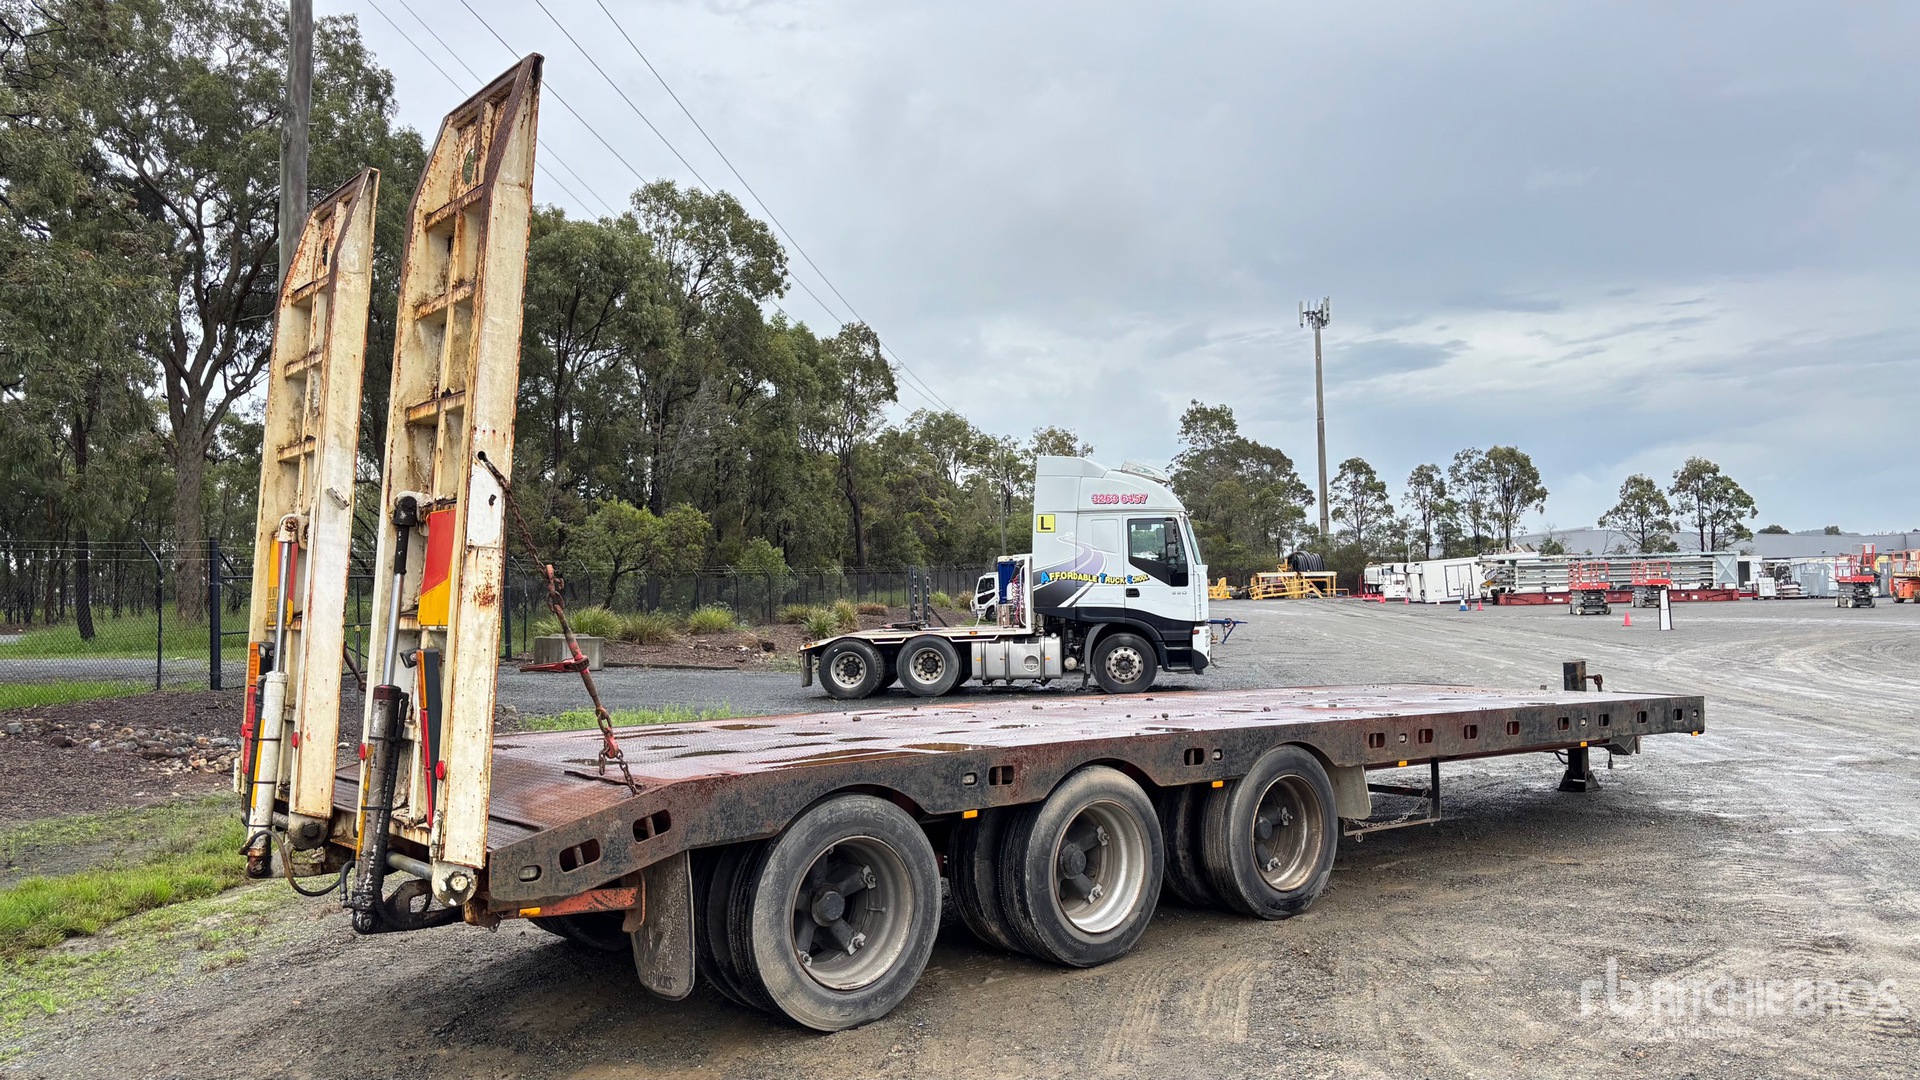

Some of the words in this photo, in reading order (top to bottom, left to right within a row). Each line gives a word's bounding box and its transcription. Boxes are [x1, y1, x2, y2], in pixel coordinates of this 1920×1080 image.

[1040, 516, 1051, 530] L
[1040, 571, 1099, 585] AFFORDABLE
[1100, 572, 1126, 585] TRUCK
[1126, 574, 1150, 585] SCHOOL
